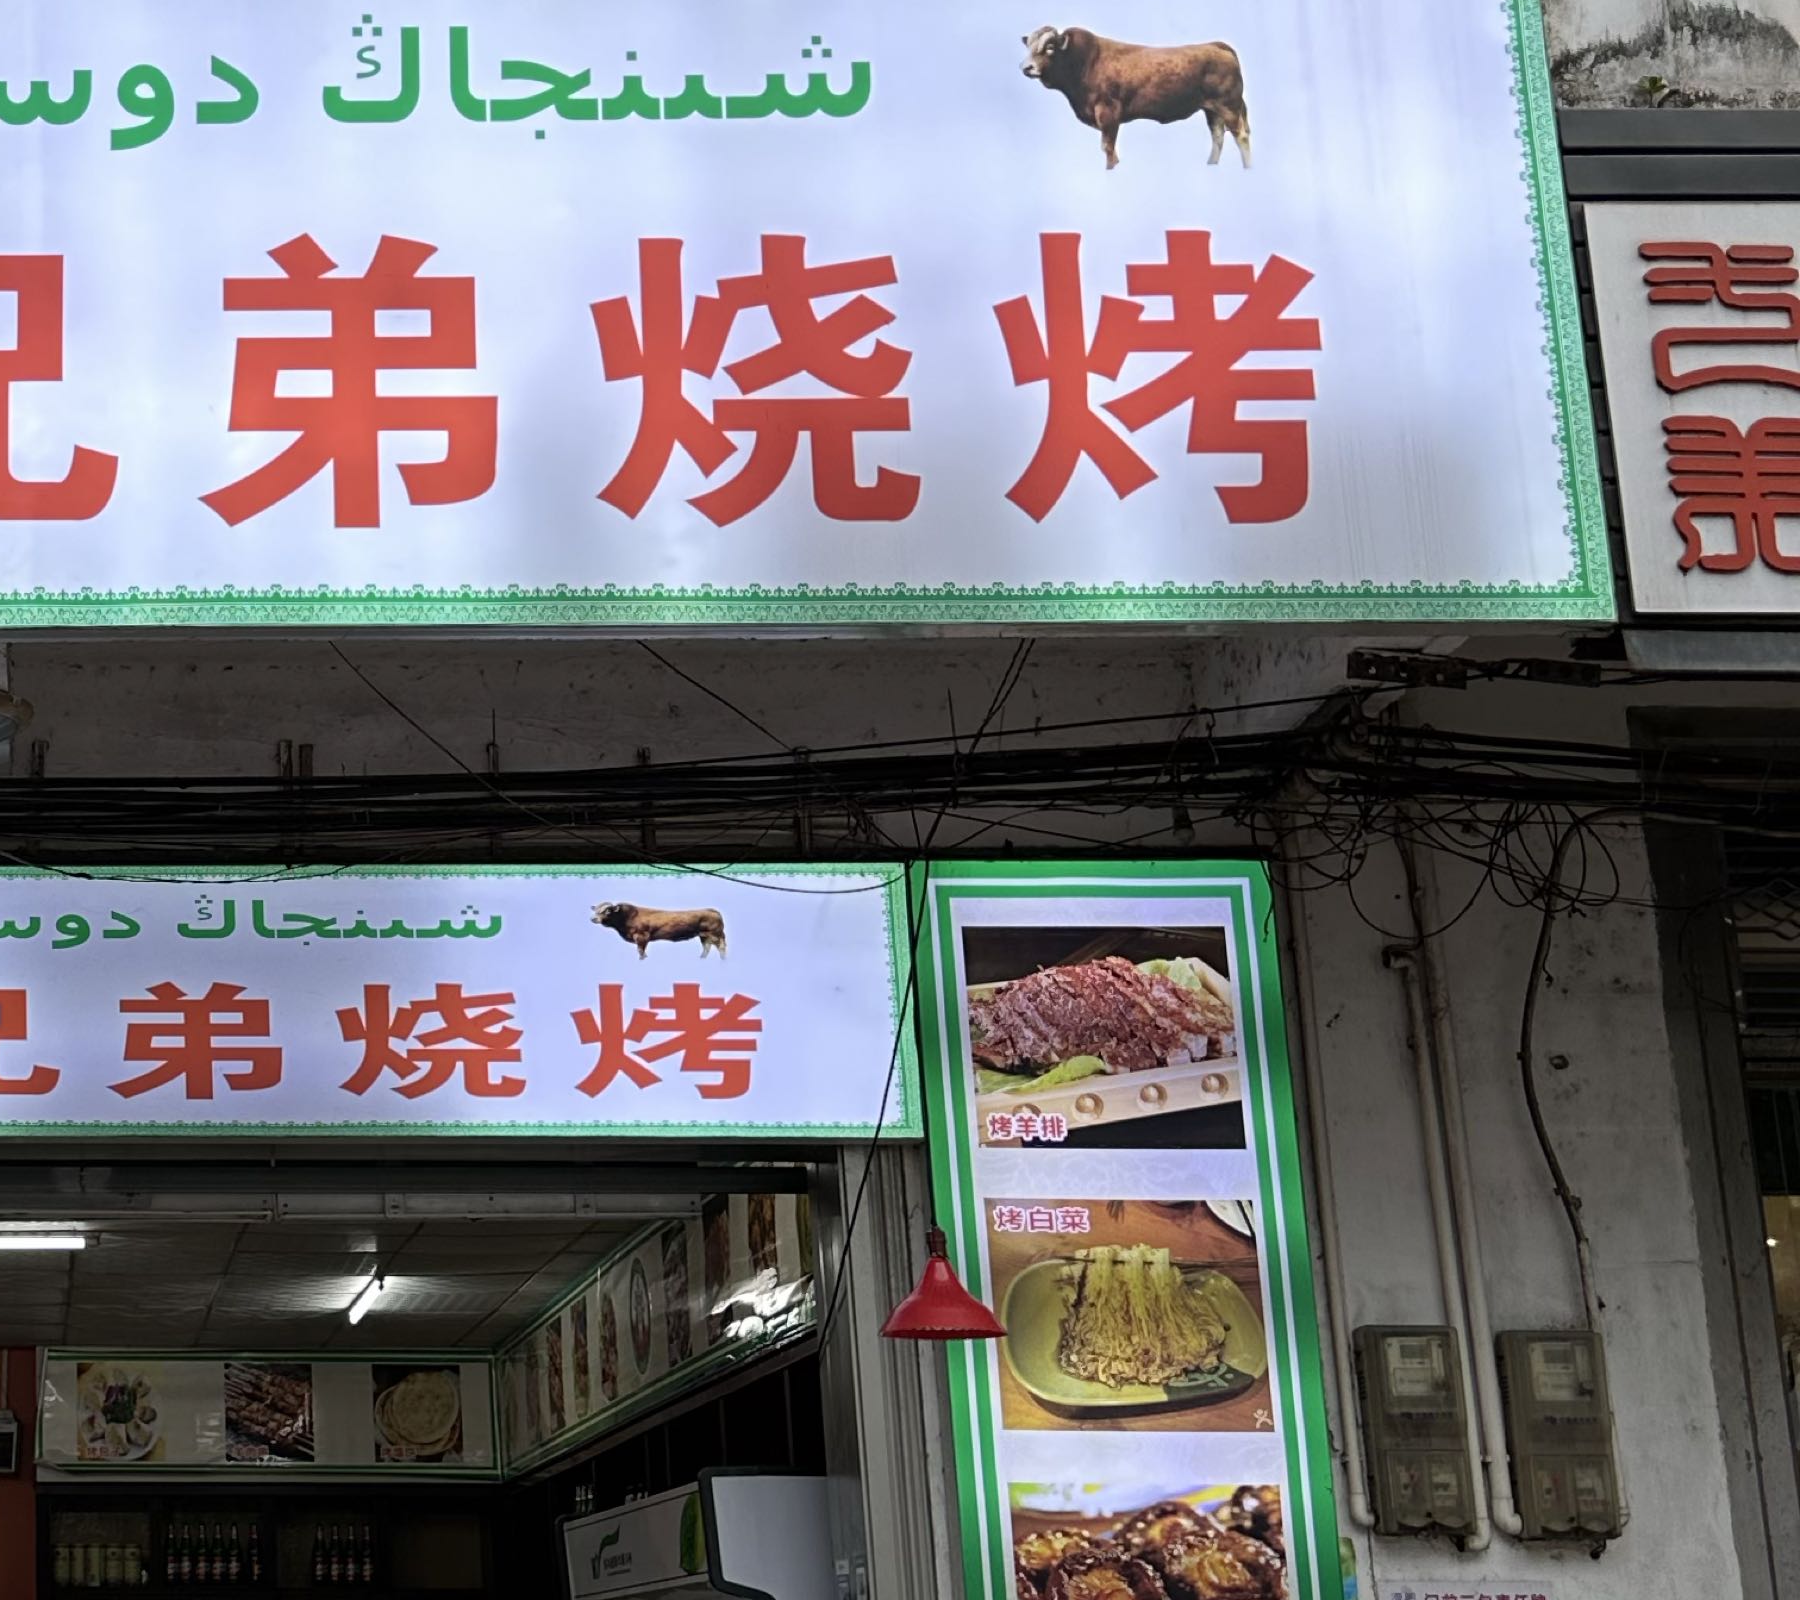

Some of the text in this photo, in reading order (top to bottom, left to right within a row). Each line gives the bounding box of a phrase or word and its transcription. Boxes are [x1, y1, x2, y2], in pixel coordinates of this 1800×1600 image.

[987, 1113, 1068, 1141] 烤羊排
[993, 1206, 1091, 1235] 烤白菜
